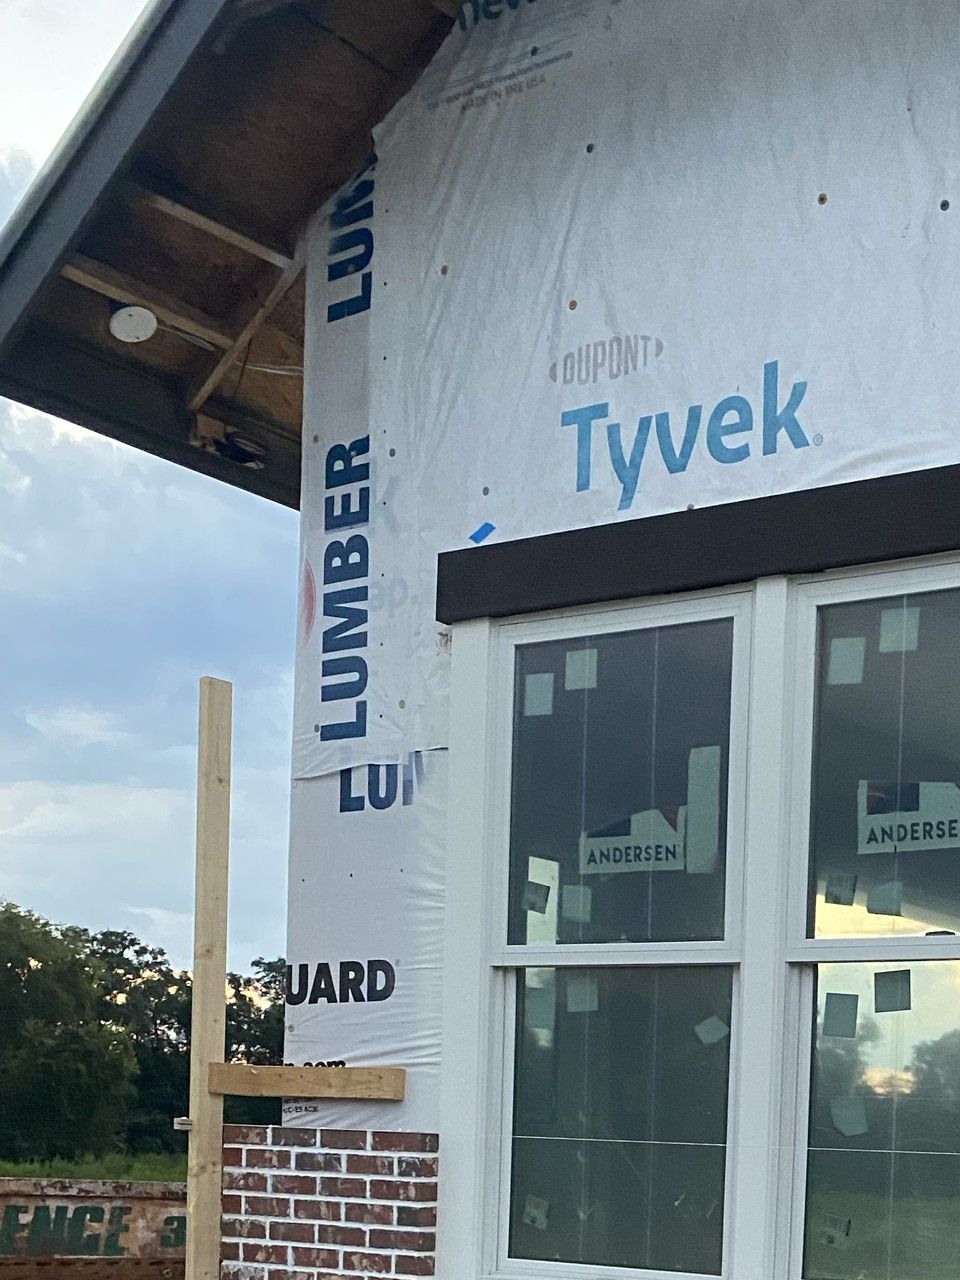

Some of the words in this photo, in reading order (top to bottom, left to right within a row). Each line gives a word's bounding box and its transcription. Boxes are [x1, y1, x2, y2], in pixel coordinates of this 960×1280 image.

[562, 334, 652, 386] DUPONT
[561, 360, 810, 511] Tyvek
[320, 433, 371, 742] LUMBER
[586, 844, 678, 866] ANDERSEN
